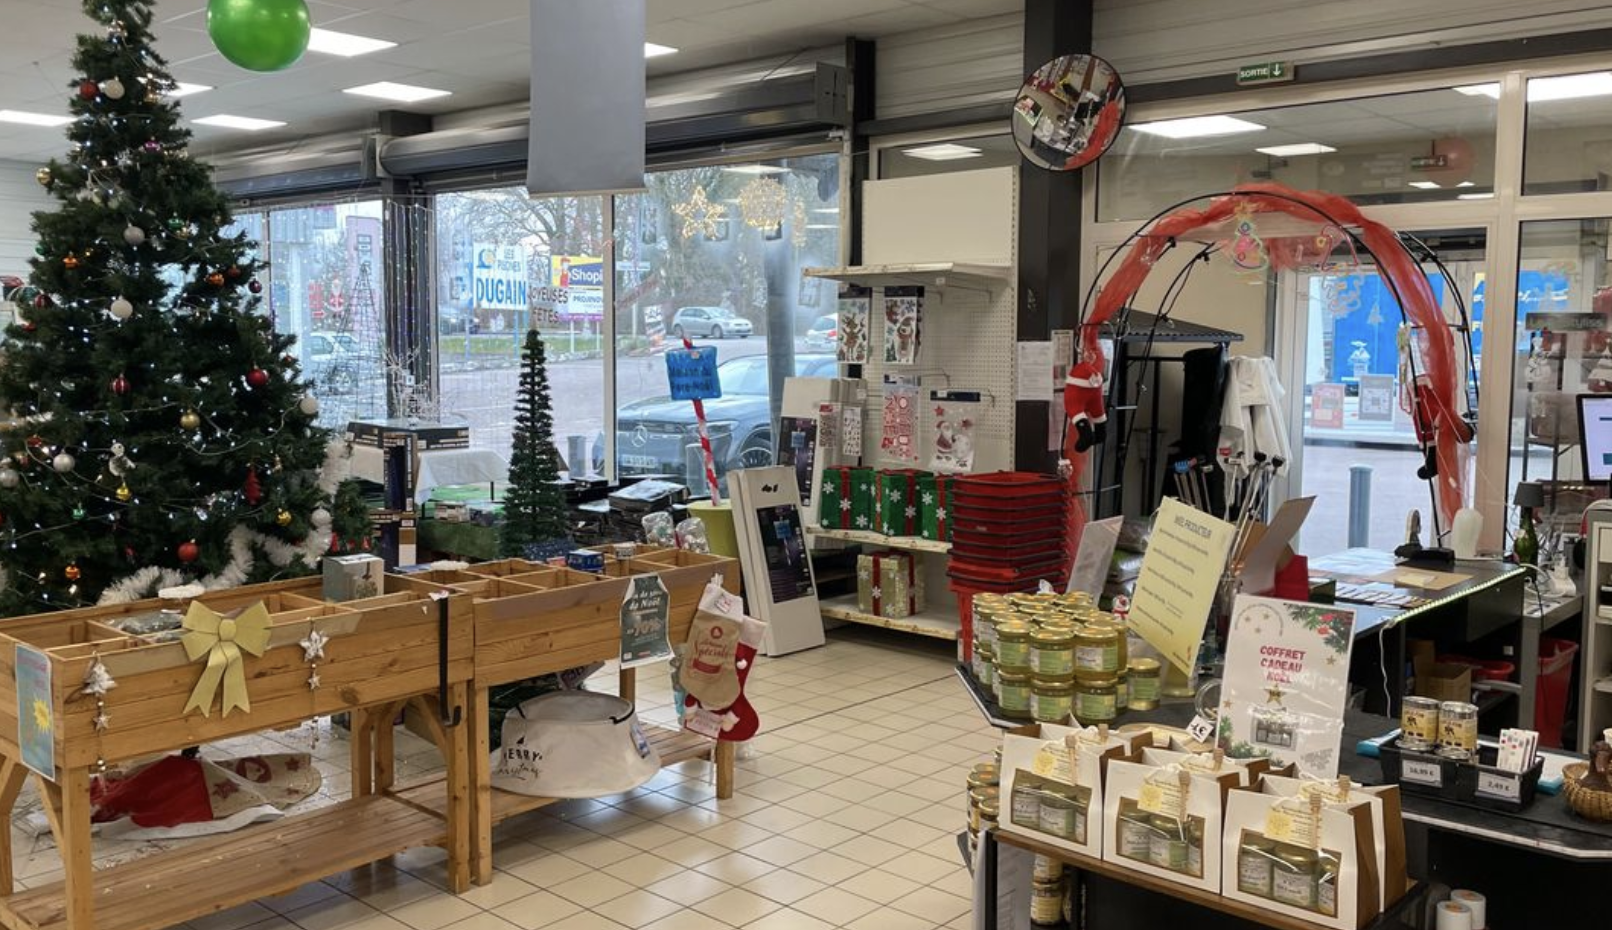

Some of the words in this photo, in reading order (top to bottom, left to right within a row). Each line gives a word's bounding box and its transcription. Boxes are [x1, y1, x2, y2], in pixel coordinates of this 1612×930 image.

[1240, 67, 1269, 78] SORTIE
[476, 277, 527, 305] DUGAIN
[527, 285, 569, 304] JOYEUSES
[1260, 645, 1307, 661] COFFRET
[1260, 658, 1303, 673] CADEAU
[503, 748, 541, 762] ERRY
